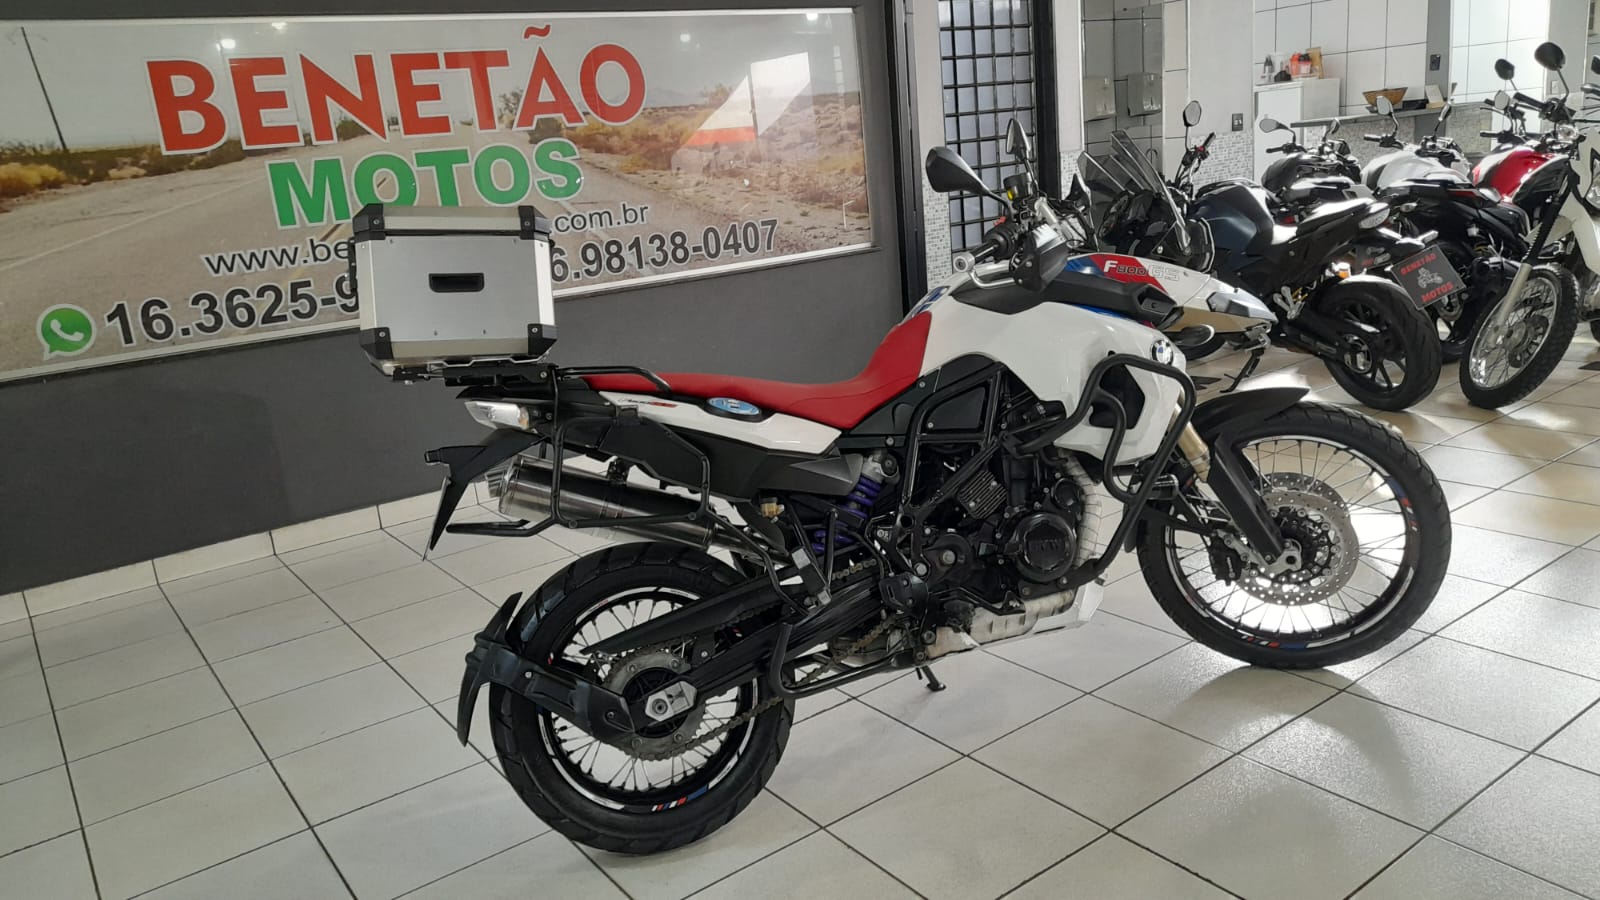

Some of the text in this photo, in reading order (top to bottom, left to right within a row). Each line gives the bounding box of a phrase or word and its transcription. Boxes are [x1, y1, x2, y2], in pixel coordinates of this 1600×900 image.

[147, 25, 645, 154] BENETÃO
[269, 140, 583, 228] MOTOS
[106, 219, 778, 346] 16.3625-9 6.98138-0407
[205, 238, 351, 275] www.be
